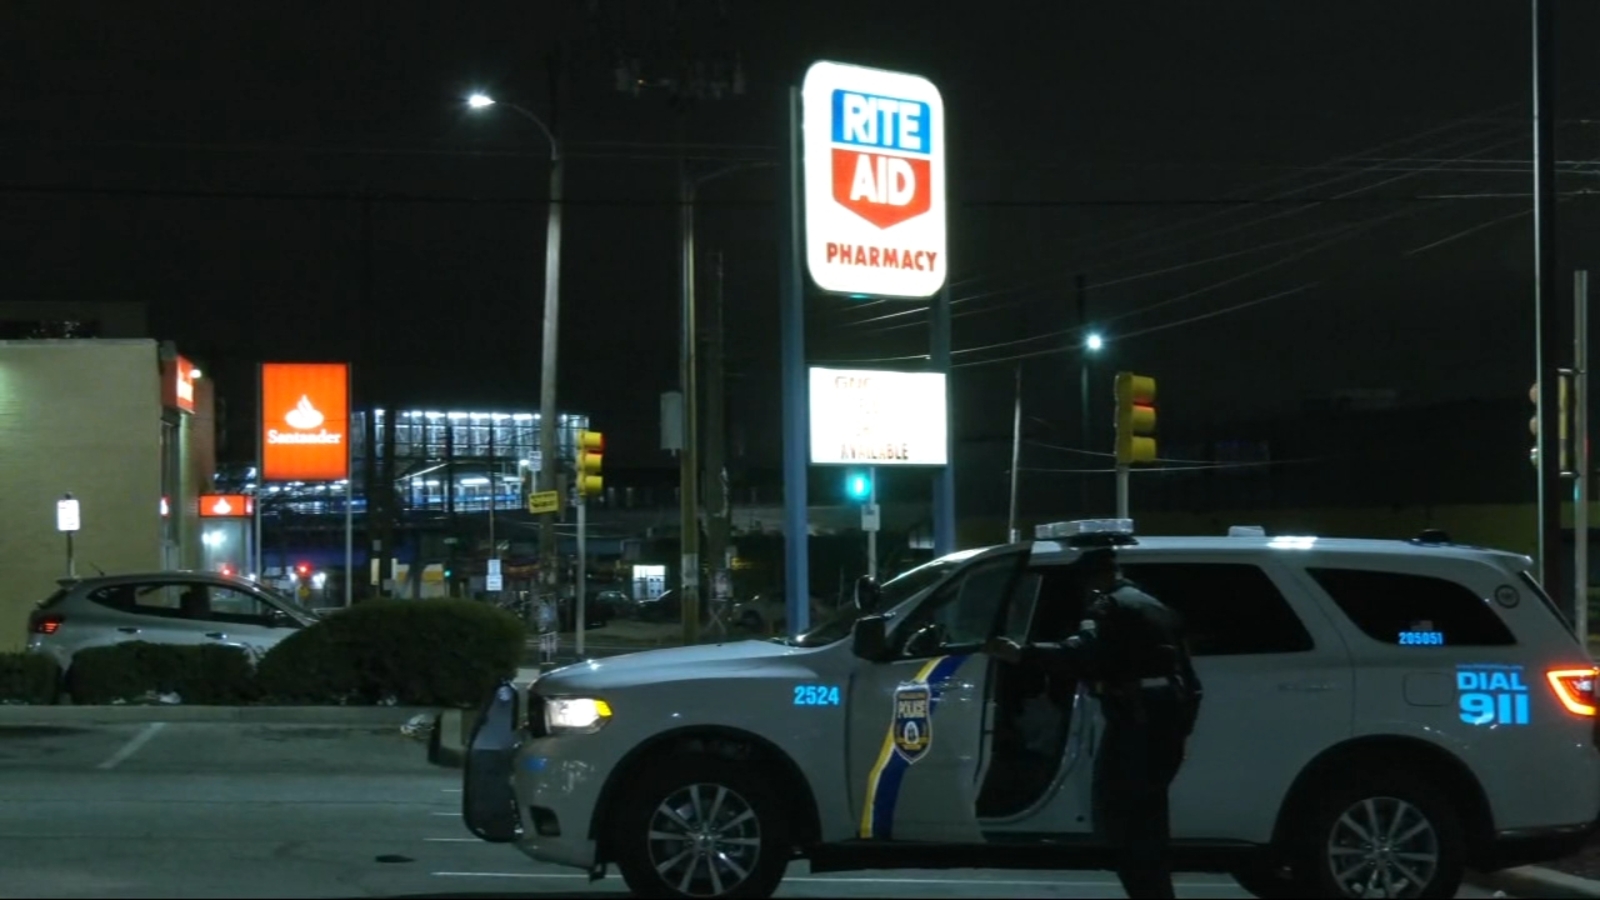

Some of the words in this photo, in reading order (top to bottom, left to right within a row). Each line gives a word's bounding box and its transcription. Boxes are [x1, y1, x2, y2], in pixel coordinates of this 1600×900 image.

[843, 93, 922, 150] RITE
[849, 154, 916, 206] AID
[825, 242, 938, 272] PHARMACY
[267, 428, 342, 444] Santander
[840, 442, 910, 461] AVAILABLE
[1398, 631, 1444, 645] 205051
[1456, 671, 1528, 691] DIAL
[793, 685, 841, 705] 2524
[898, 700, 927, 718] POLICE
[1458, 692, 1530, 725] 911
